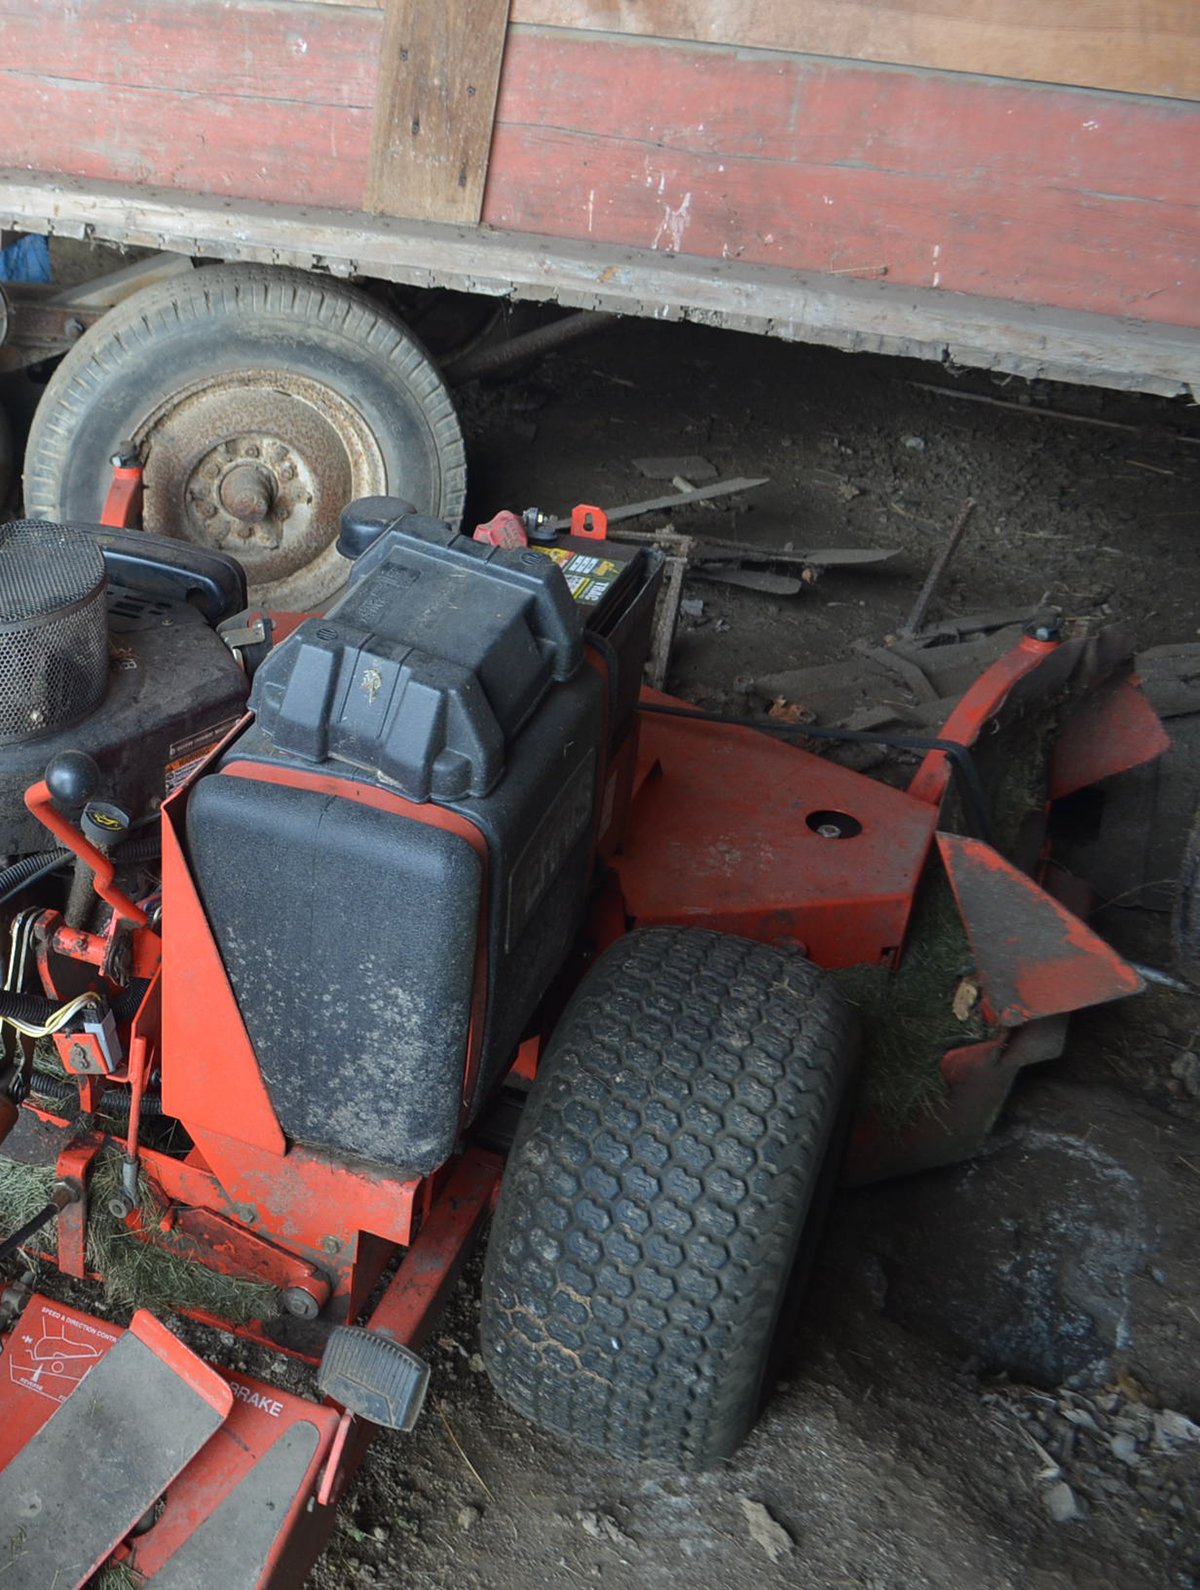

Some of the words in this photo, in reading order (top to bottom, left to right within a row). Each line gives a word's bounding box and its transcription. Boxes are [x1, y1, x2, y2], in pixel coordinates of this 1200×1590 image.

[41, 1306, 61, 1319] SPEED
[65, 1317, 97, 1335] DIRECTION
[96, 1330, 117, 1343] CONTR
